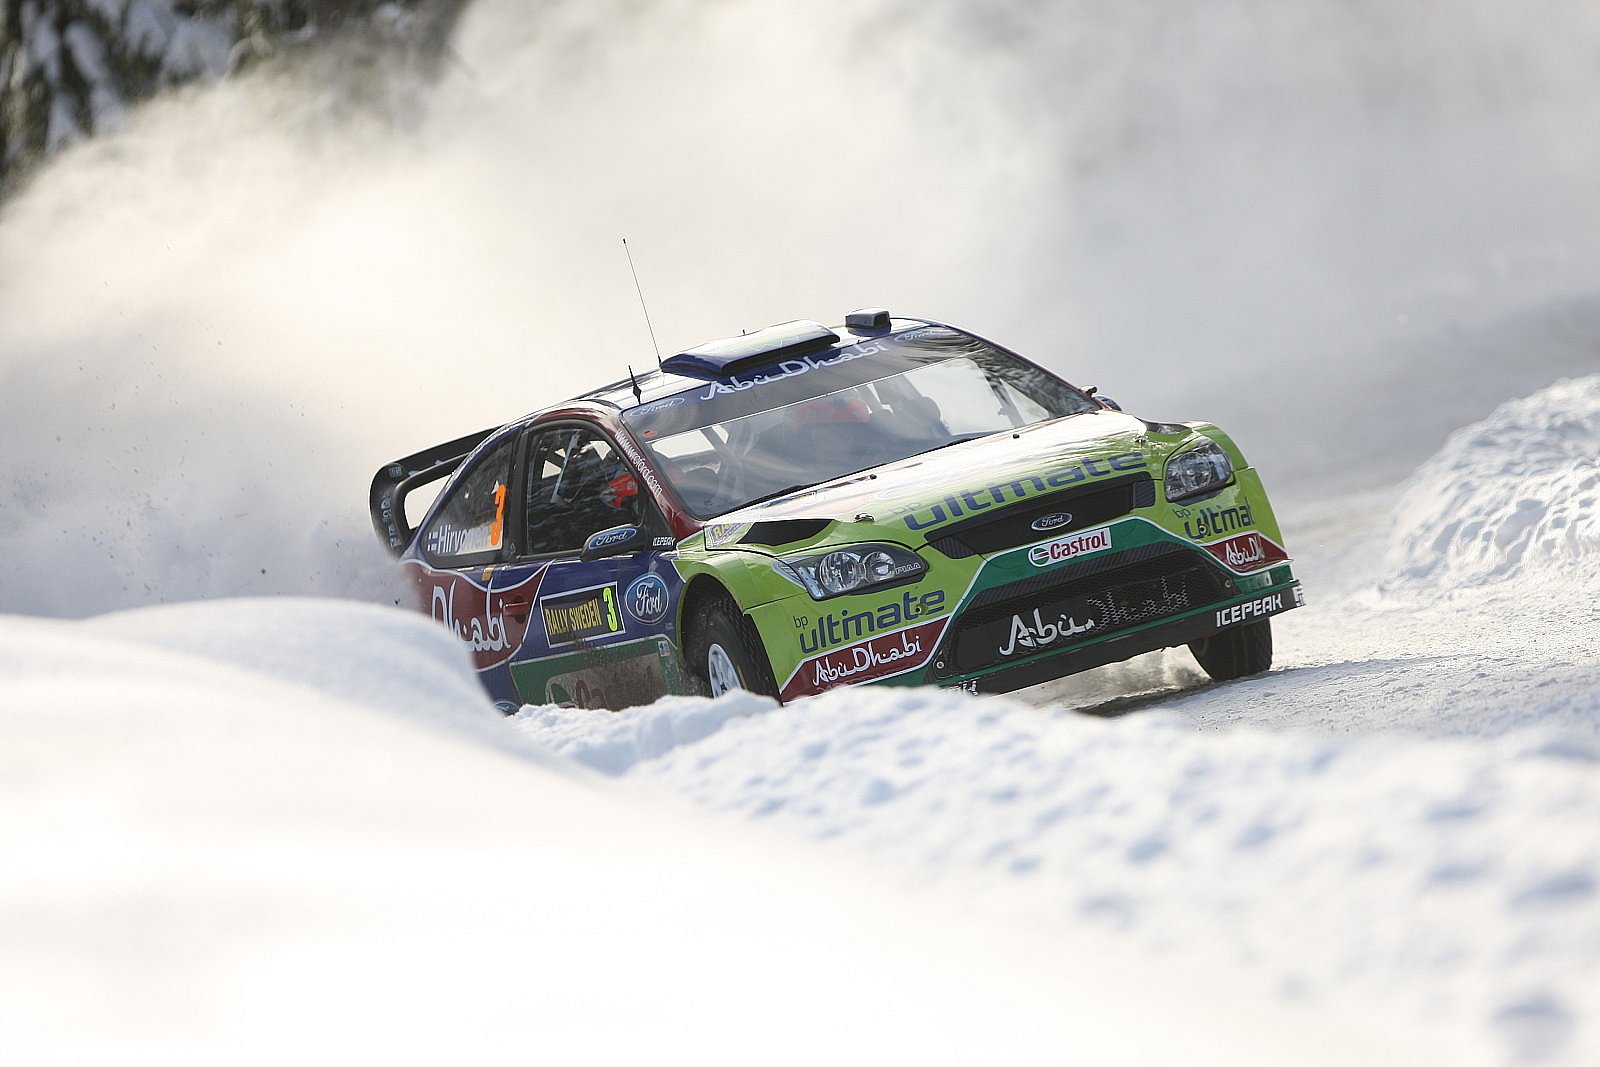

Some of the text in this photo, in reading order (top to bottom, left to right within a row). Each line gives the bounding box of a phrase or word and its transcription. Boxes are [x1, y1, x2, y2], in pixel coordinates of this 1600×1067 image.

[903, 451, 1149, 531] ultimate
[1041, 514, 1066, 528] Ford
[1172, 508, 1191, 519] bp
[596, 529, 629, 546] Ford
[1049, 530, 1109, 561] Castrol
[602, 587, 619, 632] 3
[634, 581, 663, 617] Ford
[1216, 593, 1284, 628] ICEPEAK
[544, 598, 603, 636] RALLY SWEDEN
[793, 615, 809, 630] bp
[799, 589, 946, 655] ultimate
